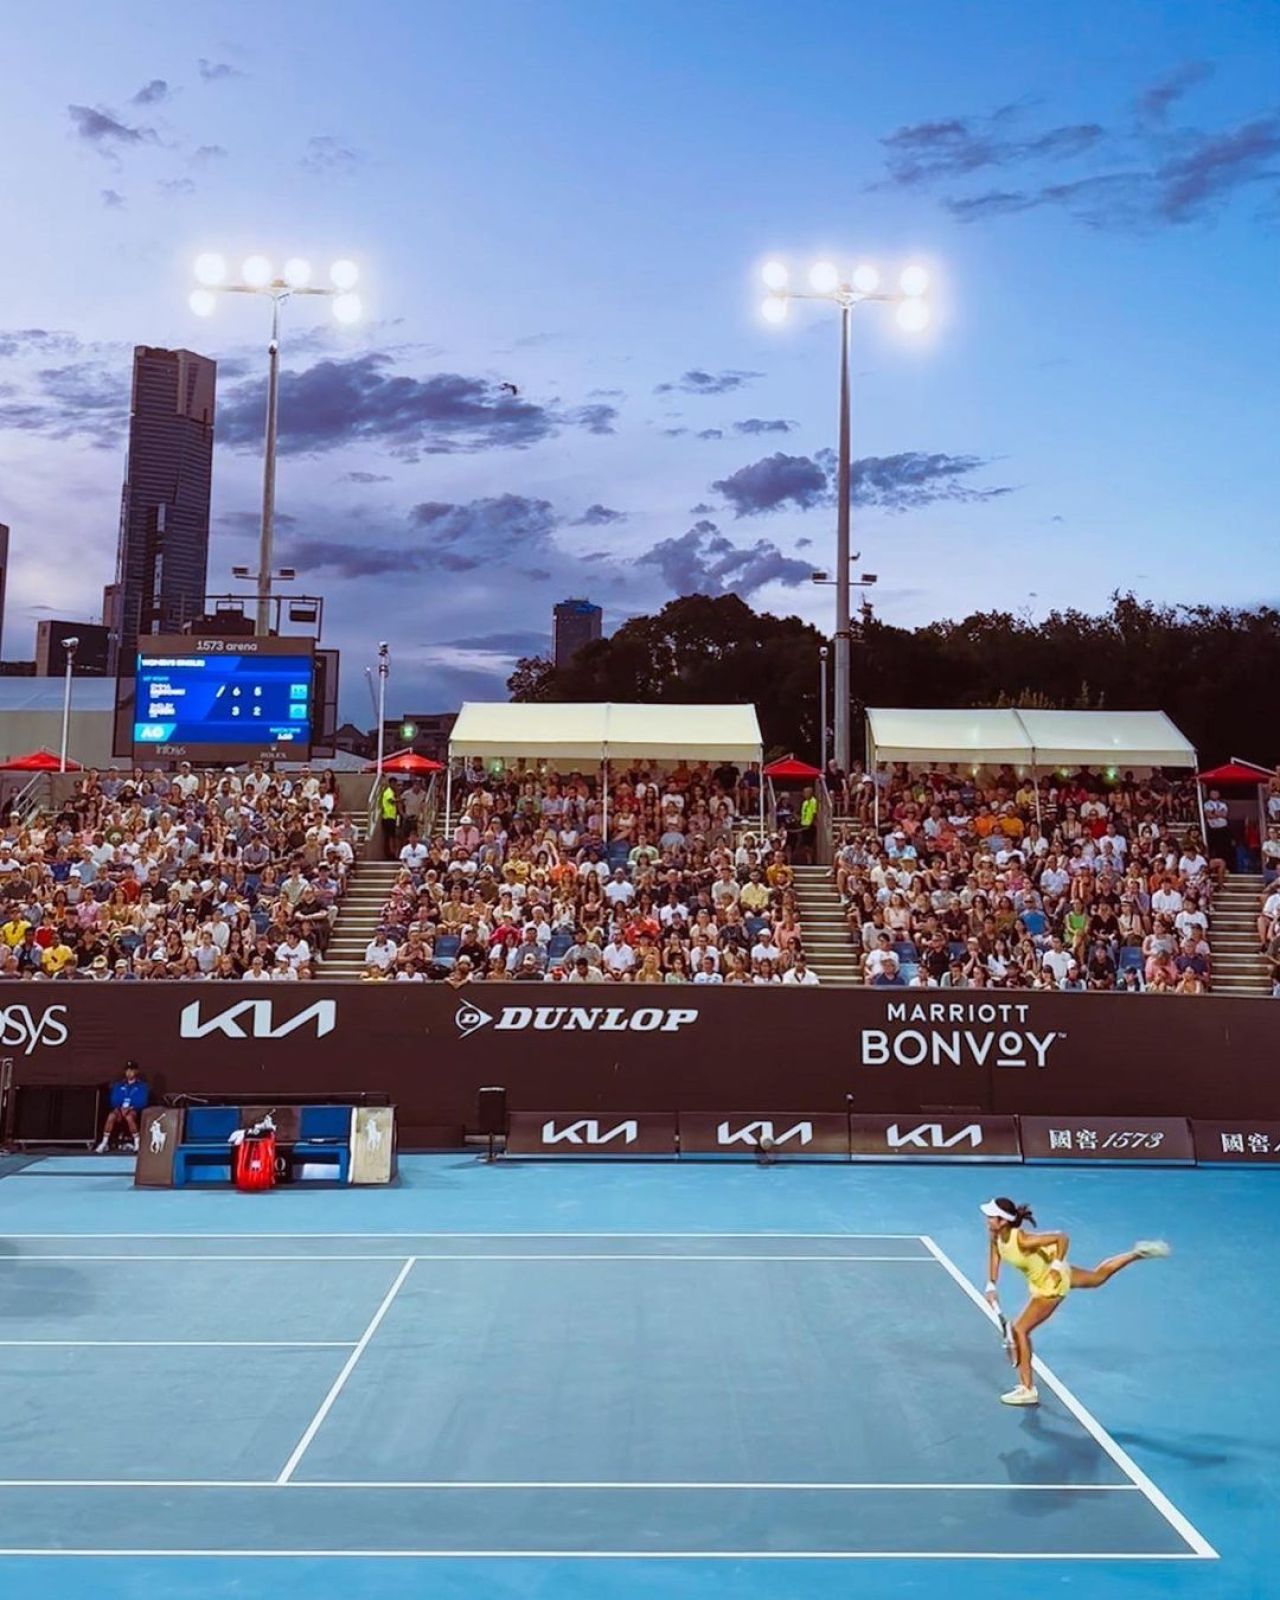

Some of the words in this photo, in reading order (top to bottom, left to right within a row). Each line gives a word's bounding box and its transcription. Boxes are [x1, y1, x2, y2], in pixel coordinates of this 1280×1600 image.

[196, 640, 224, 651] 1573
[226, 642, 258, 651] arena
[232, 686, 241, 697] 6
[231, 706, 240, 716] 3
[252, 706, 262, 716] 2
[180, 999, 336, 1039] KIA
[494, 1007, 699, 1032] DUNLOP
[887, 1003, 1029, 1023] MARRIOTT
[0, 1004, 68, 1055] sys
[861, 1029, 1057, 1067] BONVOY
[542, 1120, 638, 1145] KIA
[886, 1123, 983, 1148] KIA
[1101, 1131, 1165, 1149] 1573
